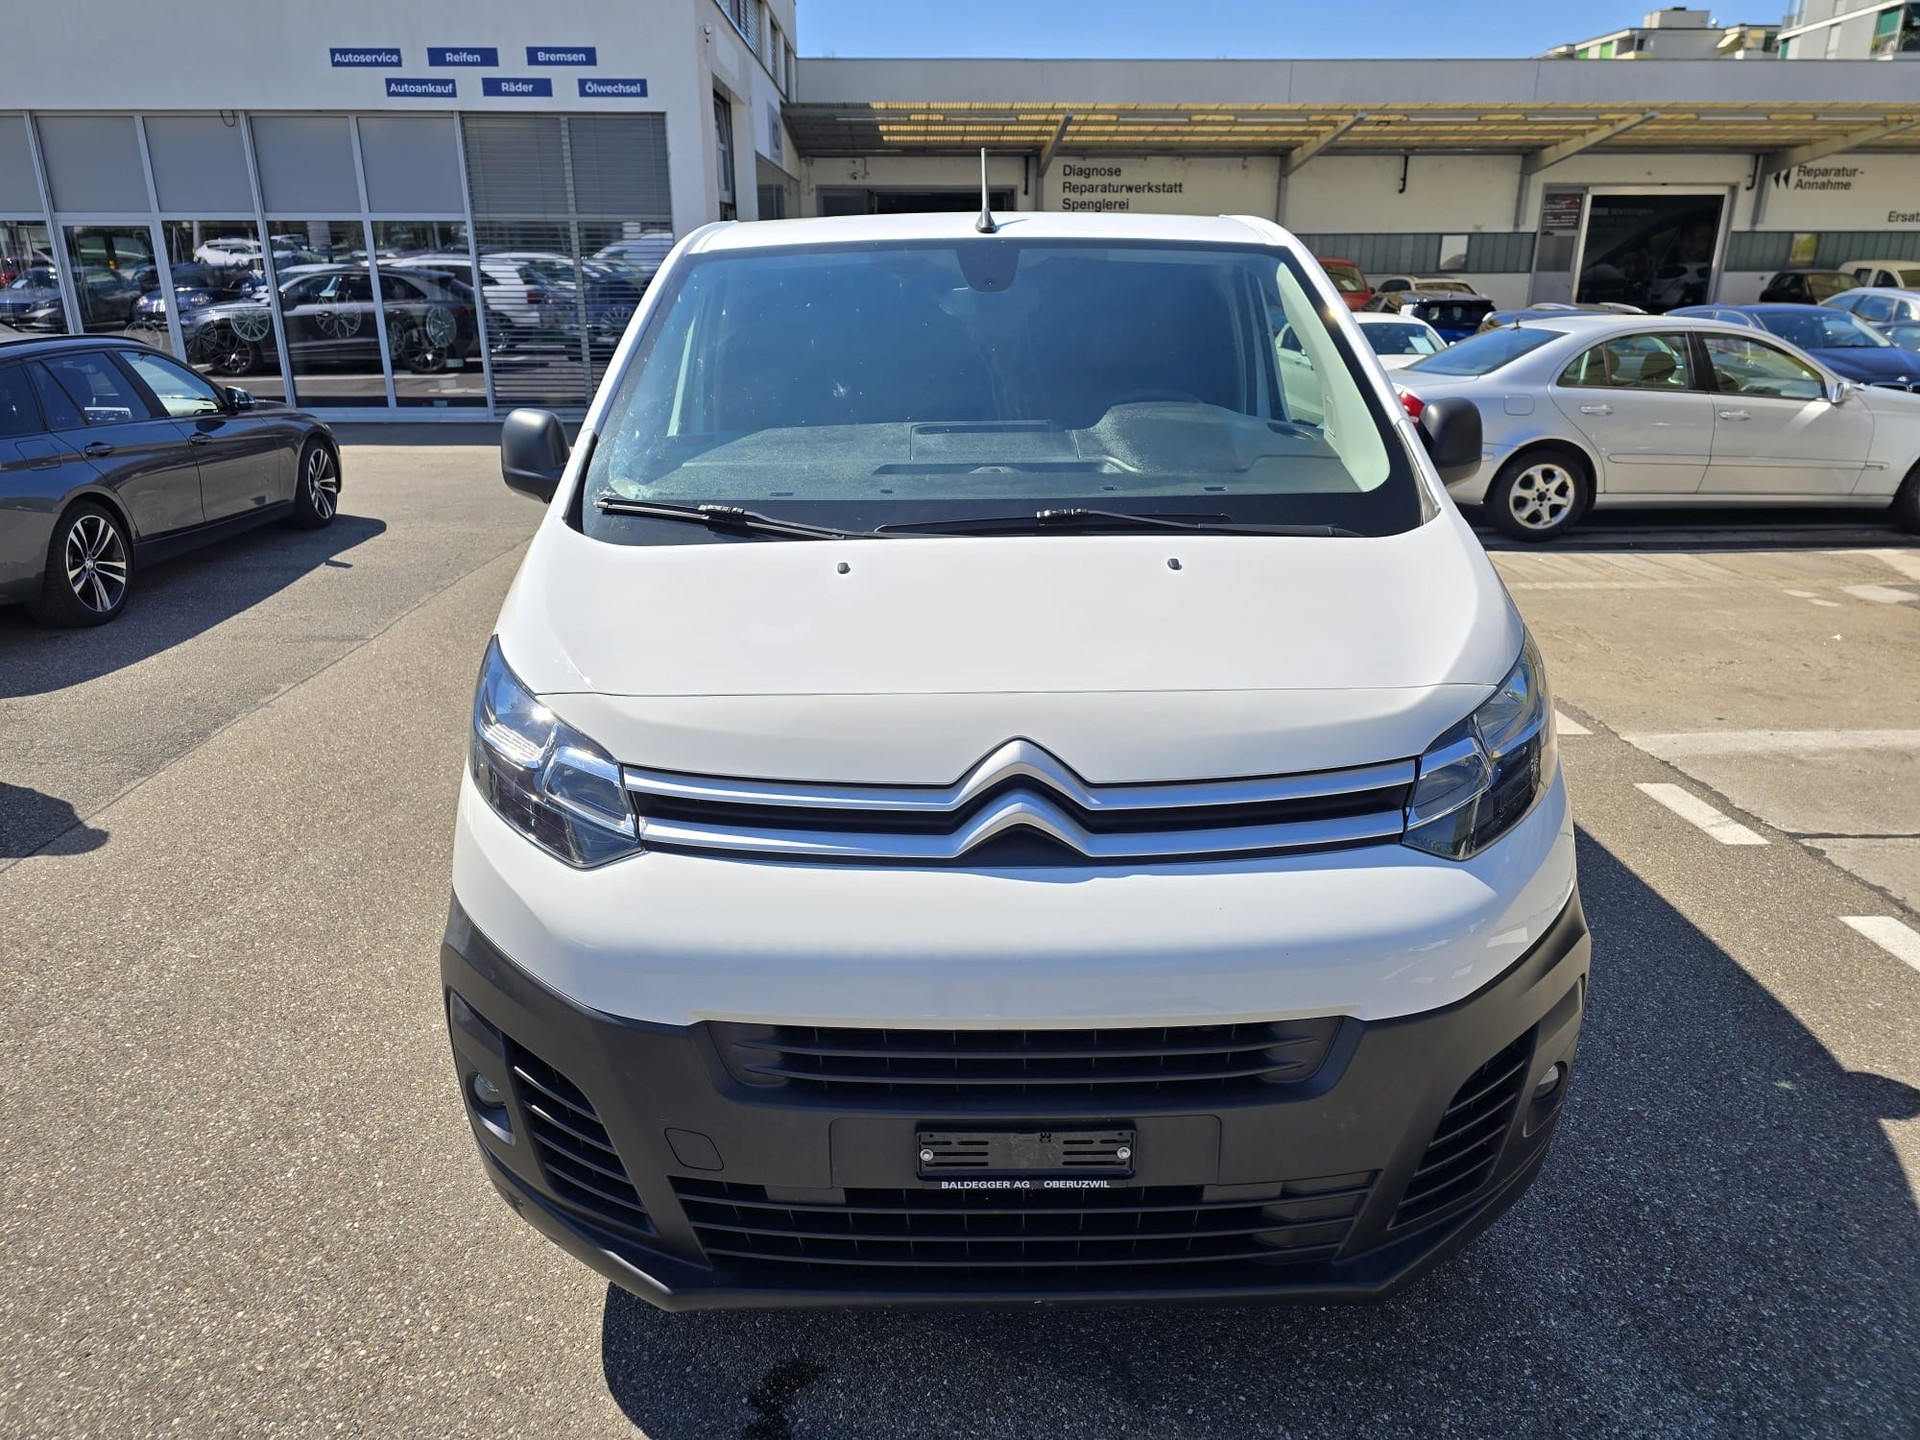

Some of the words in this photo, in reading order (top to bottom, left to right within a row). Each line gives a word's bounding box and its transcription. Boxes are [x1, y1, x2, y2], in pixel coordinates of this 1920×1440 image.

[333, 52, 399, 64] Autoservice
[445, 52, 481, 63] Reifen
[537, 51, 586, 62] Bremsen
[389, 82, 454, 94] Autoankauf
[501, 82, 534, 93] Räder
[585, 81, 641, 93] Ölwechsel
[1062, 164, 1122, 179] Diagnose
[1062, 181, 1183, 196] Reparaturwerkstatt
[1793, 179, 1852, 191] Annahme
[1062, 198, 1130, 212] Spenglerei
[941, 1181, 1011, 1190] BALDEGGER
[1013, 1181, 1031, 1190] AG
[1043, 1180, 1111, 1189] OBERUZWIL
